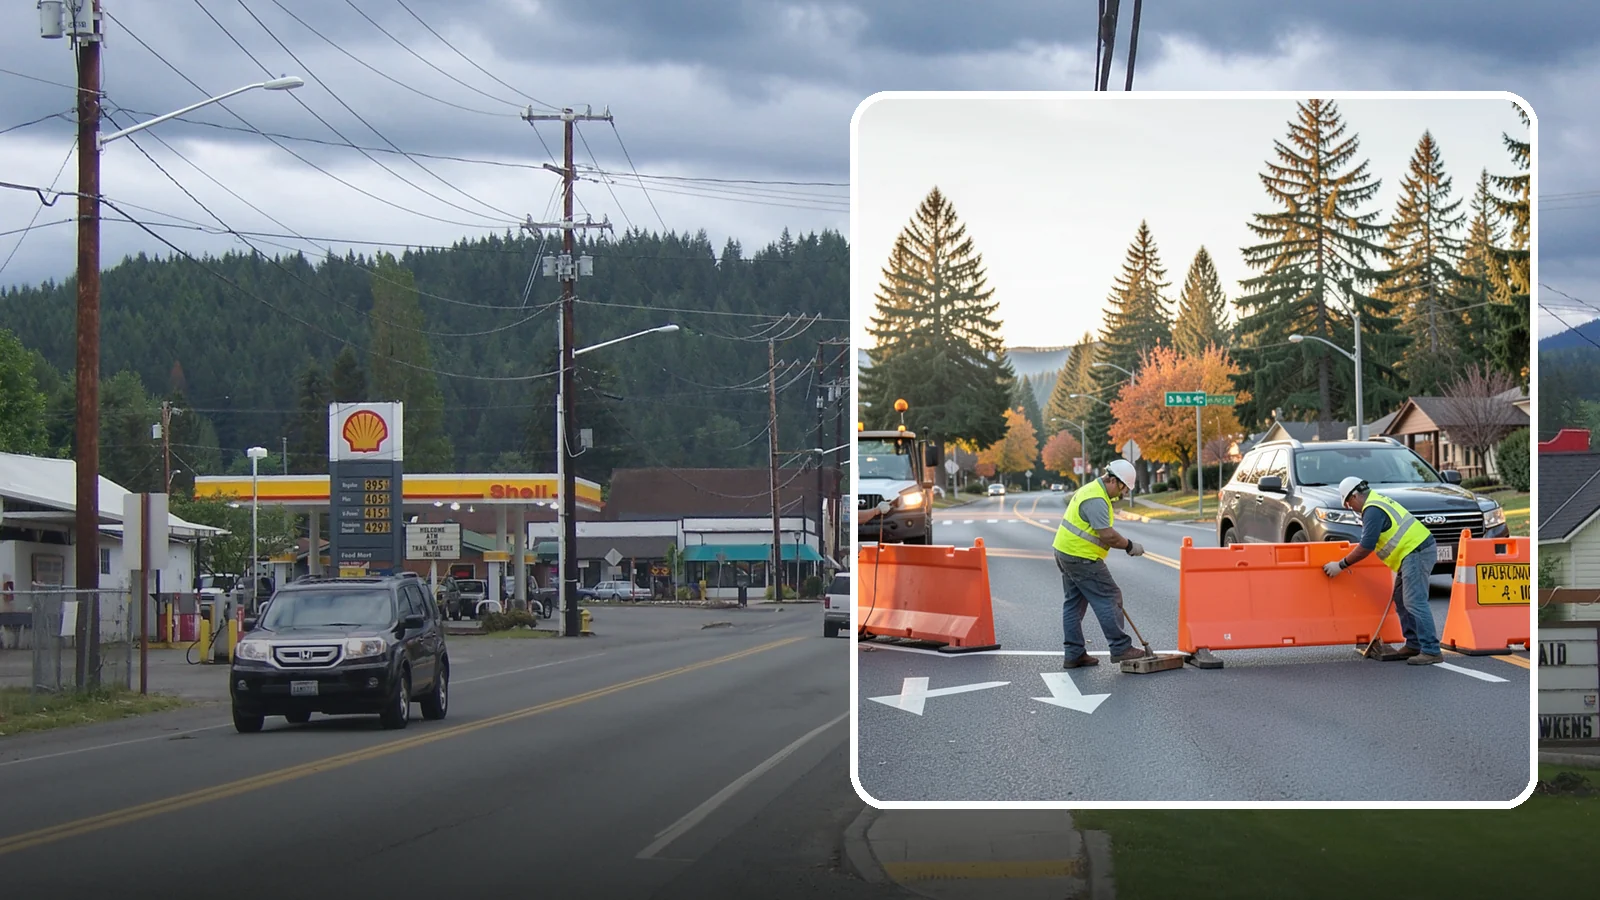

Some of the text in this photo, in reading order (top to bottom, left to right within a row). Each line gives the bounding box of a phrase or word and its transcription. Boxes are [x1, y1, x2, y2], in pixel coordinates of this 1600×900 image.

[366, 480, 384, 490] 395
[490, 484, 547, 499] Shell
[366, 494, 384, 504] 405
[366, 508, 384, 518] 415
[366, 522, 384, 532] 429
